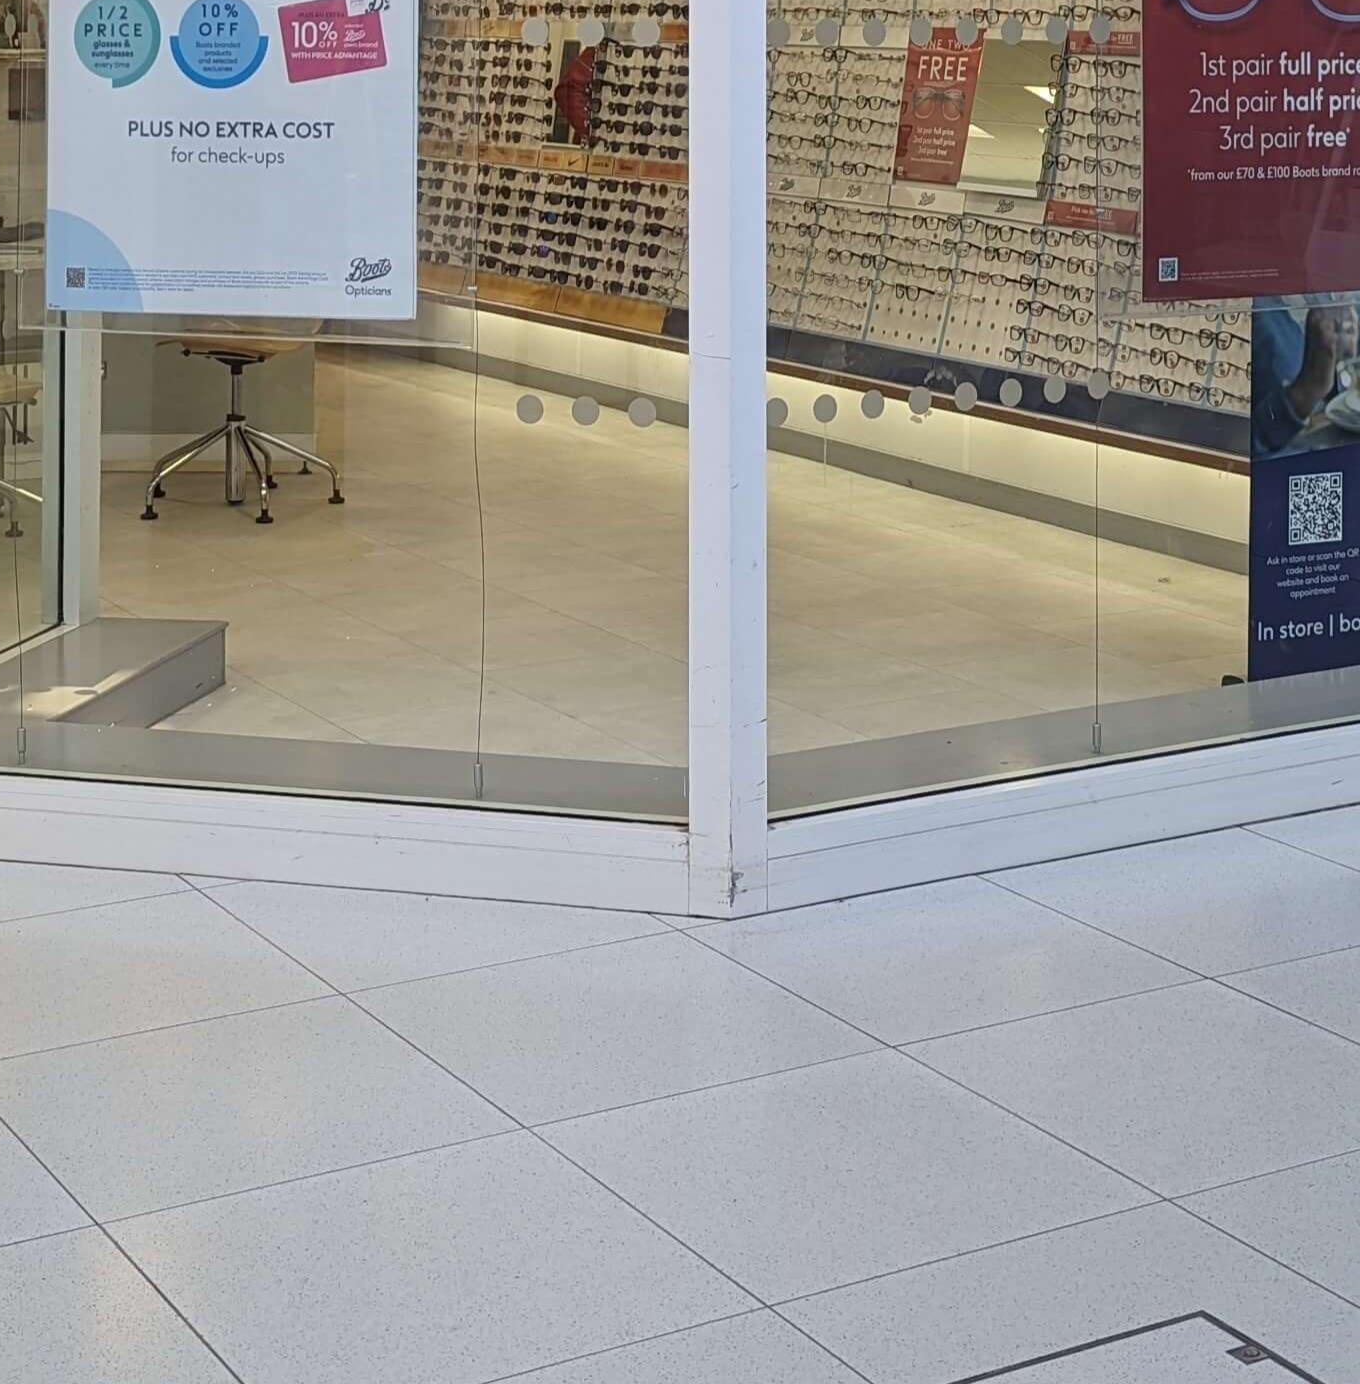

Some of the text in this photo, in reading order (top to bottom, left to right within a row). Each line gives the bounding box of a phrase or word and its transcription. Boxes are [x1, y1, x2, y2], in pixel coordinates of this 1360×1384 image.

[97, 5, 128, 21] 1/2
[201, 3, 239, 18] 10%
[84, 23, 143, 38] PRICE
[198, 22, 239, 37] OFF
[291, 20, 338, 48] 10%
[92, 40, 131, 49] glasses &
[318, 40, 337, 48] OFF
[91, 49, 134, 60] sunglasses
[204, 49, 232, 58] products
[917, 54, 970, 82] FREE
[1200, 51, 1227, 77] 1st
[1231, 53, 1274, 84] pair
[1279, 51, 1312, 76] full
[1188, 88, 1230, 114] 2nd
[1236, 90, 1278, 120] pair
[1282, 87, 1324, 112] half
[128, 120, 335, 139] PLUS NO EXTRA COST
[1219, 125, 1254, 151] 3rd
[1260, 125, 1301, 156] pair
[170, 146, 286, 169] for check-ups
[1216, 169, 1235, 181] our
[1235, 167, 1256, 180] £70
[1256, 167, 1266, 179] &
[1266, 166, 1291, 180] £100
[1292, 166, 1321, 179] Boots
[1321, 164, 1351, 178] brand
[344, 256, 393, 284] Boots
[344, 284, 393, 298] Opticians
[1288, 554, 1307, 564] store
[1316, 553, 1333, 561] scan
[1334, 551, 1346, 559] the
[1346, 547, 1360, 558] QR
[1304, 576, 1320, 585] and
[1338, 573, 1350, 582] an
[1257, 621, 1274, 642] In
[1279, 617, 1324, 639] store
